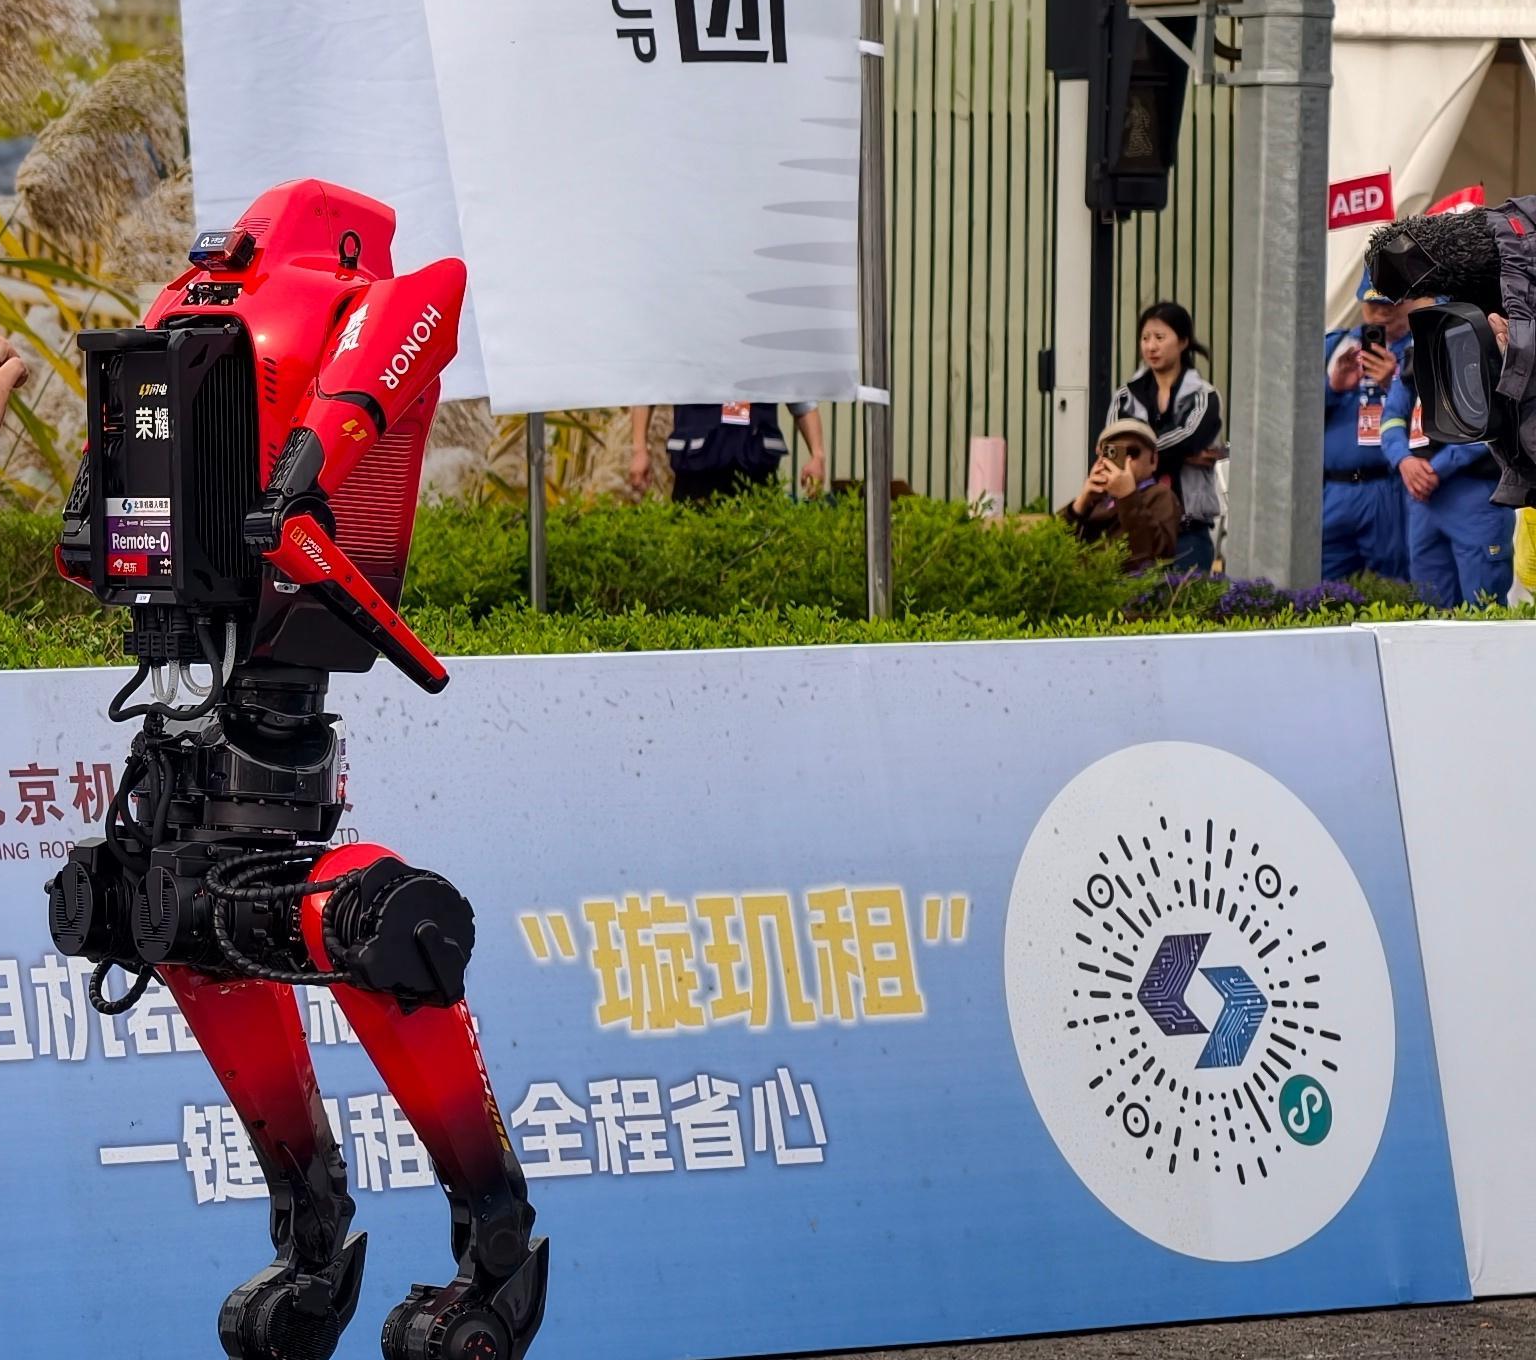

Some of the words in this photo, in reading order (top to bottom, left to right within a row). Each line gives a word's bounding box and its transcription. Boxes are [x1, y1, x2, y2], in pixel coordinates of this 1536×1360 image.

[1331, 185, 1385, 220] AED
[378, 303, 442, 390] HONOR
[511, 1067, 827, 1179] 全程省心
